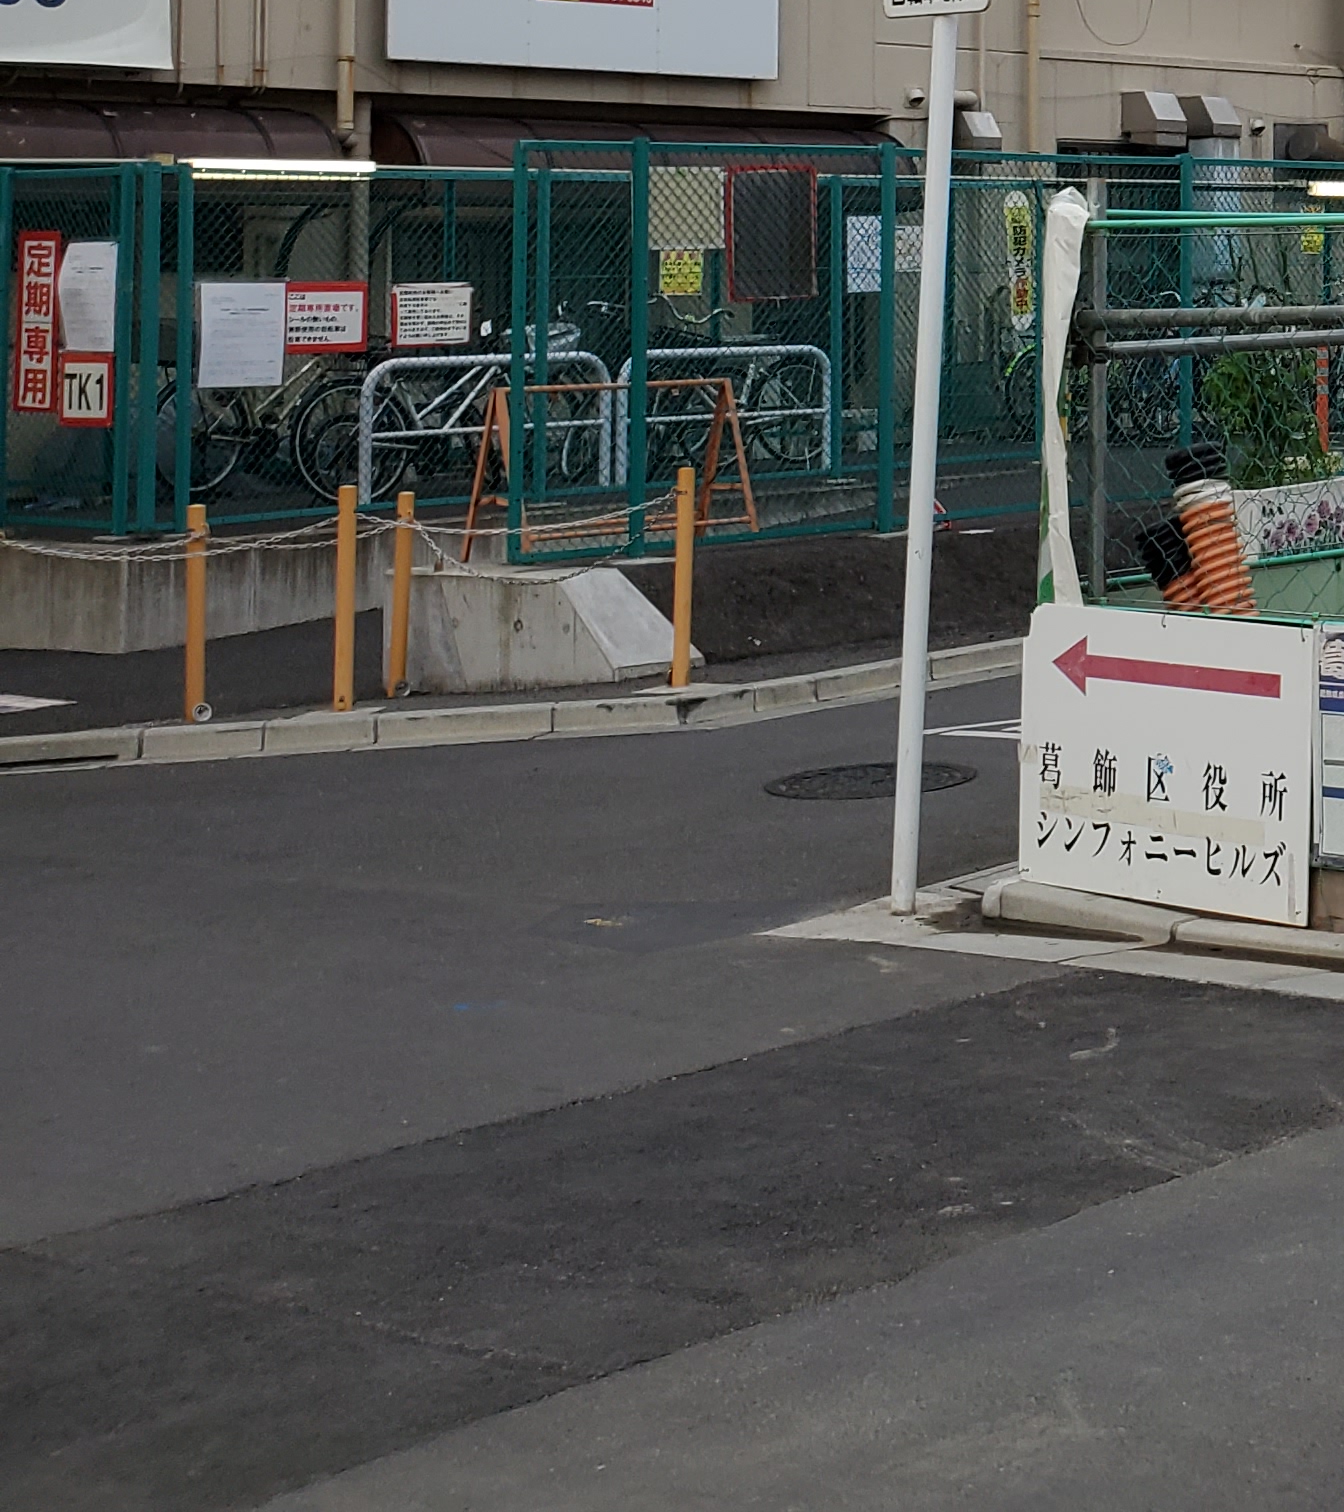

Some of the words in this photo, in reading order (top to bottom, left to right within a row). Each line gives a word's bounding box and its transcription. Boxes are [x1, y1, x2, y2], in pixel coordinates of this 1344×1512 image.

[21, 242, 53, 406] 定期専用
[63, 372, 105, 411] TK1
[1039, 741, 1288, 822] 葛飾区役所
[1036, 811, 1287, 886] シンフォニーヒルズ
